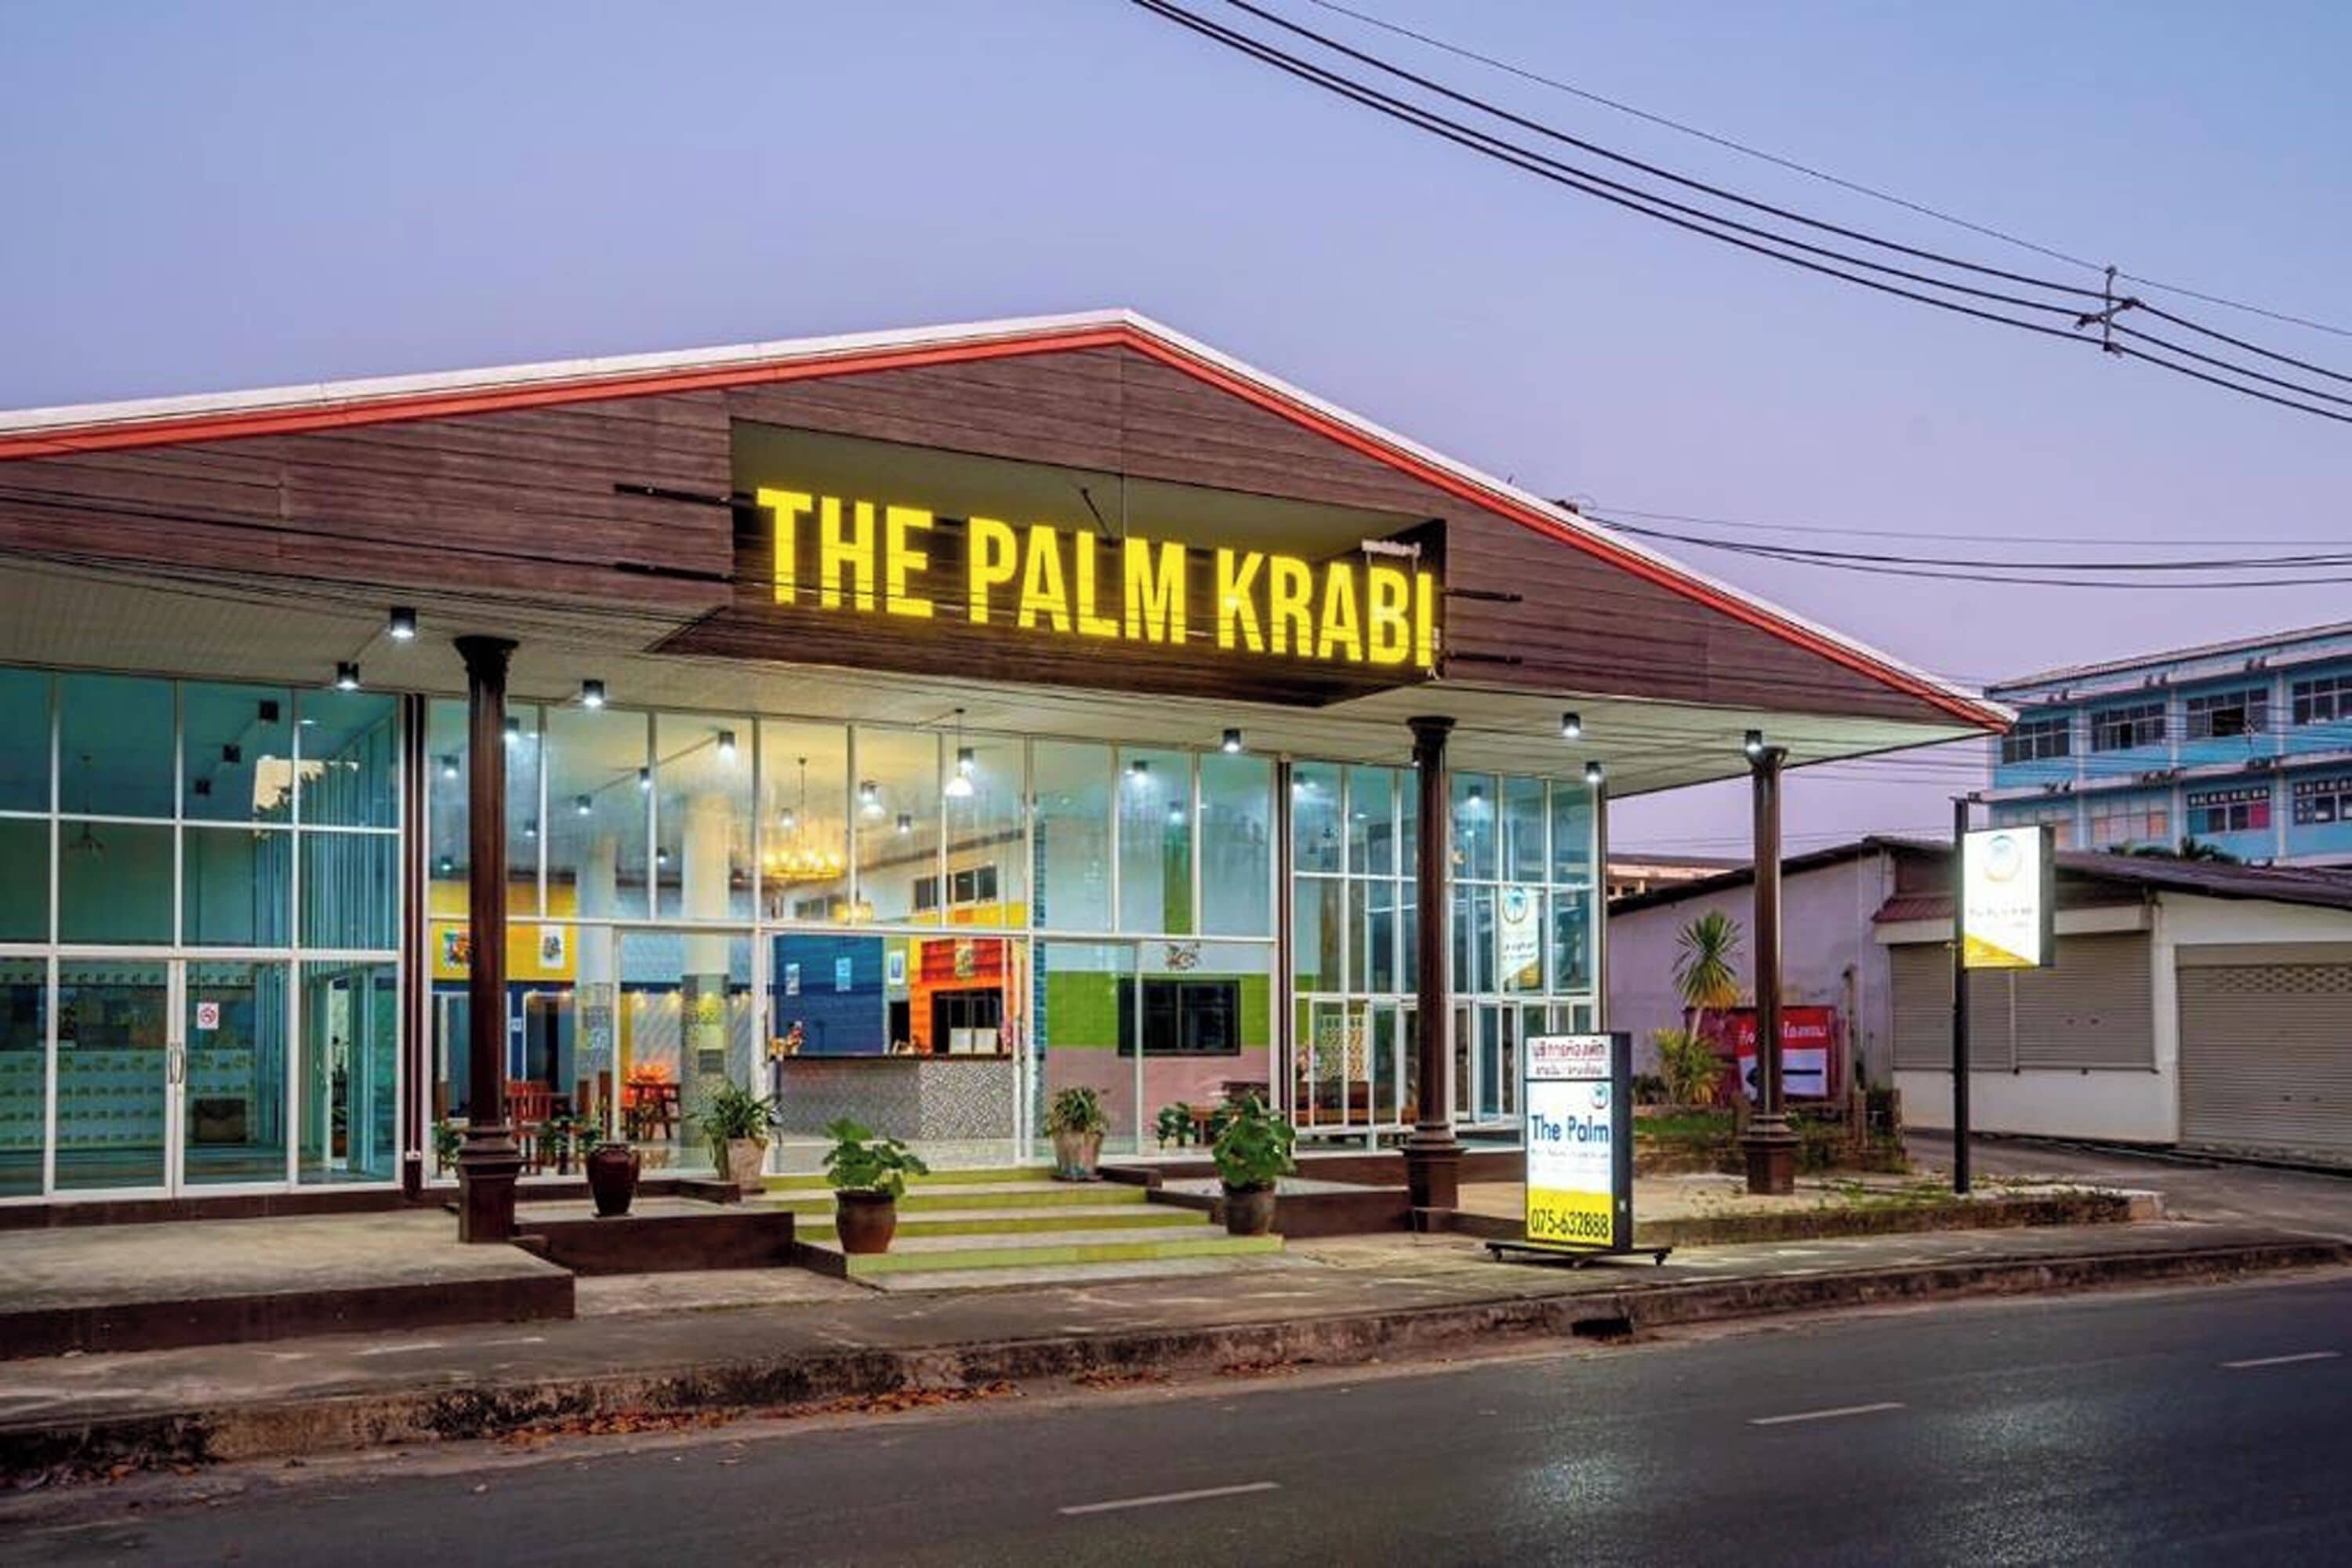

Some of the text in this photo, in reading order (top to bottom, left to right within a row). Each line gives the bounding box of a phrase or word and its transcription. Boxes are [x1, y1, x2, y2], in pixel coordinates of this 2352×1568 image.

[757, 488, 1434, 668] THE PALM KRABI
[1531, 1114, 1609, 1143] The Palm
